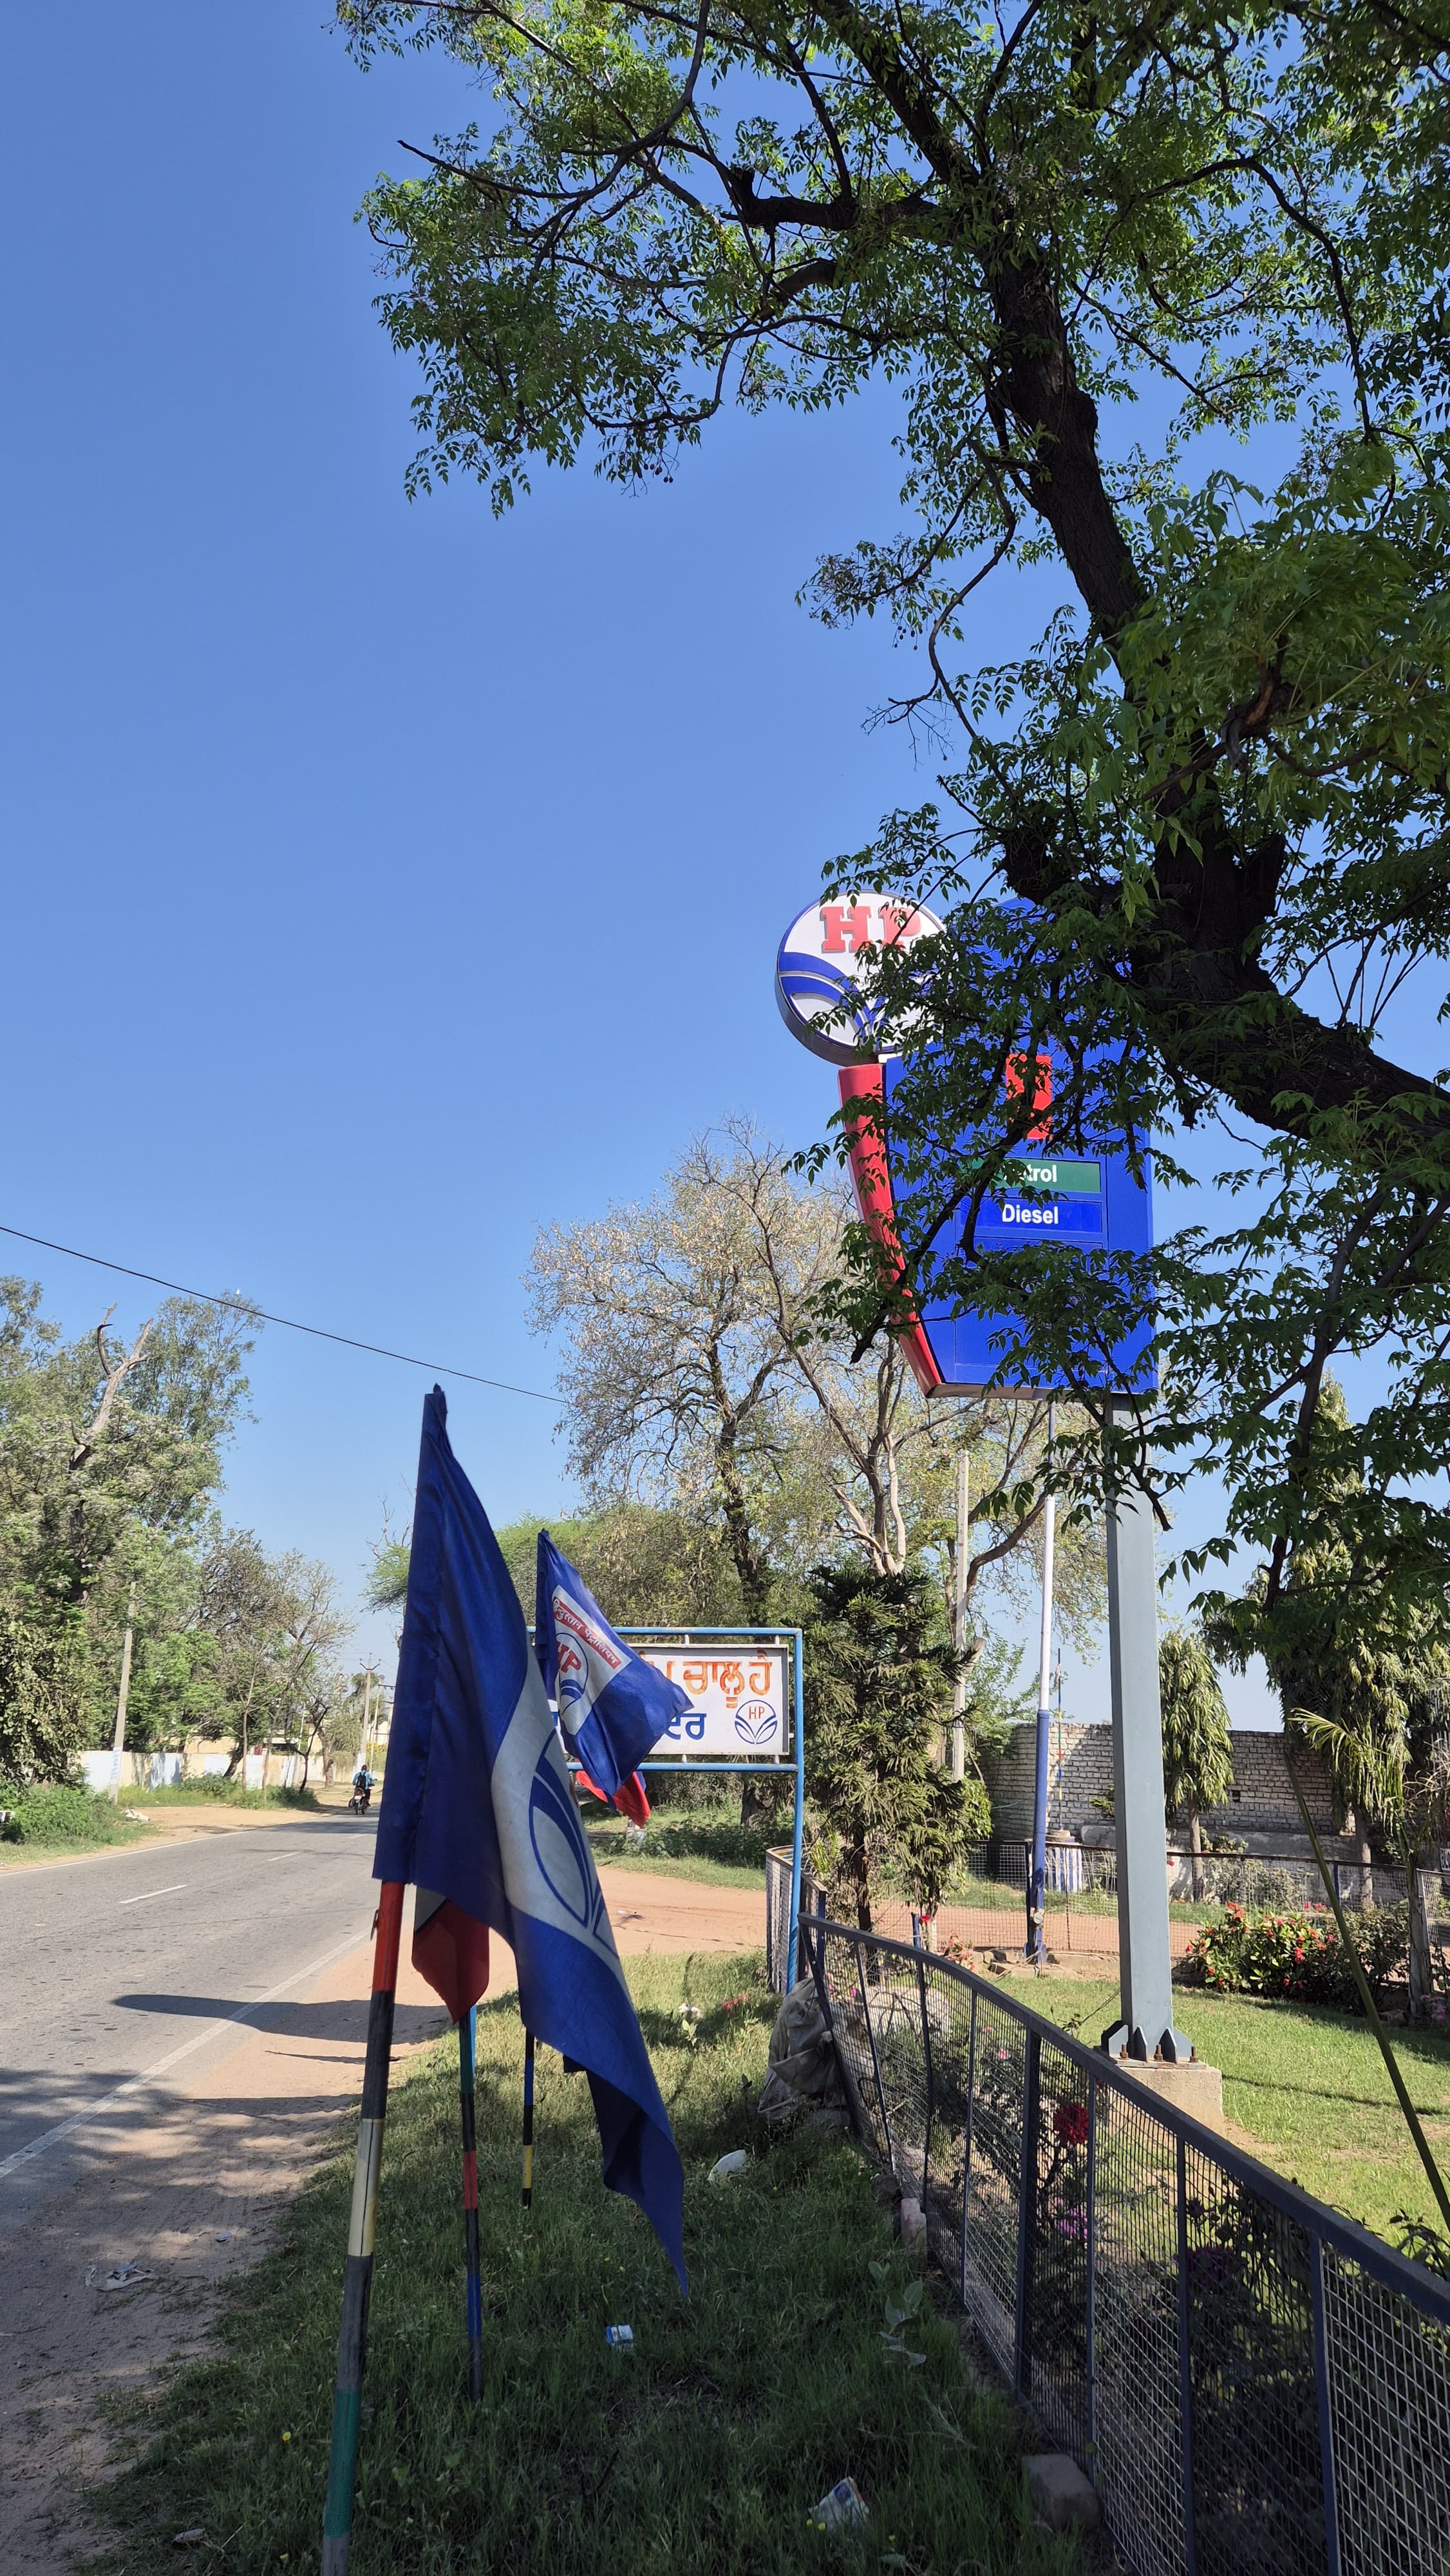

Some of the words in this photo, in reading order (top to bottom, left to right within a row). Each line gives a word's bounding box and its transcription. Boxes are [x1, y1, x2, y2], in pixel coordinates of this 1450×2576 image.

[820, 905, 922, 954] HP
[1003, 1164, 1057, 1183] trol
[1002, 1203, 1059, 1225] Diesel
[683, 1660, 745, 1709] ਚਾਲੂ
[748, 1706, 765, 1720] HP
